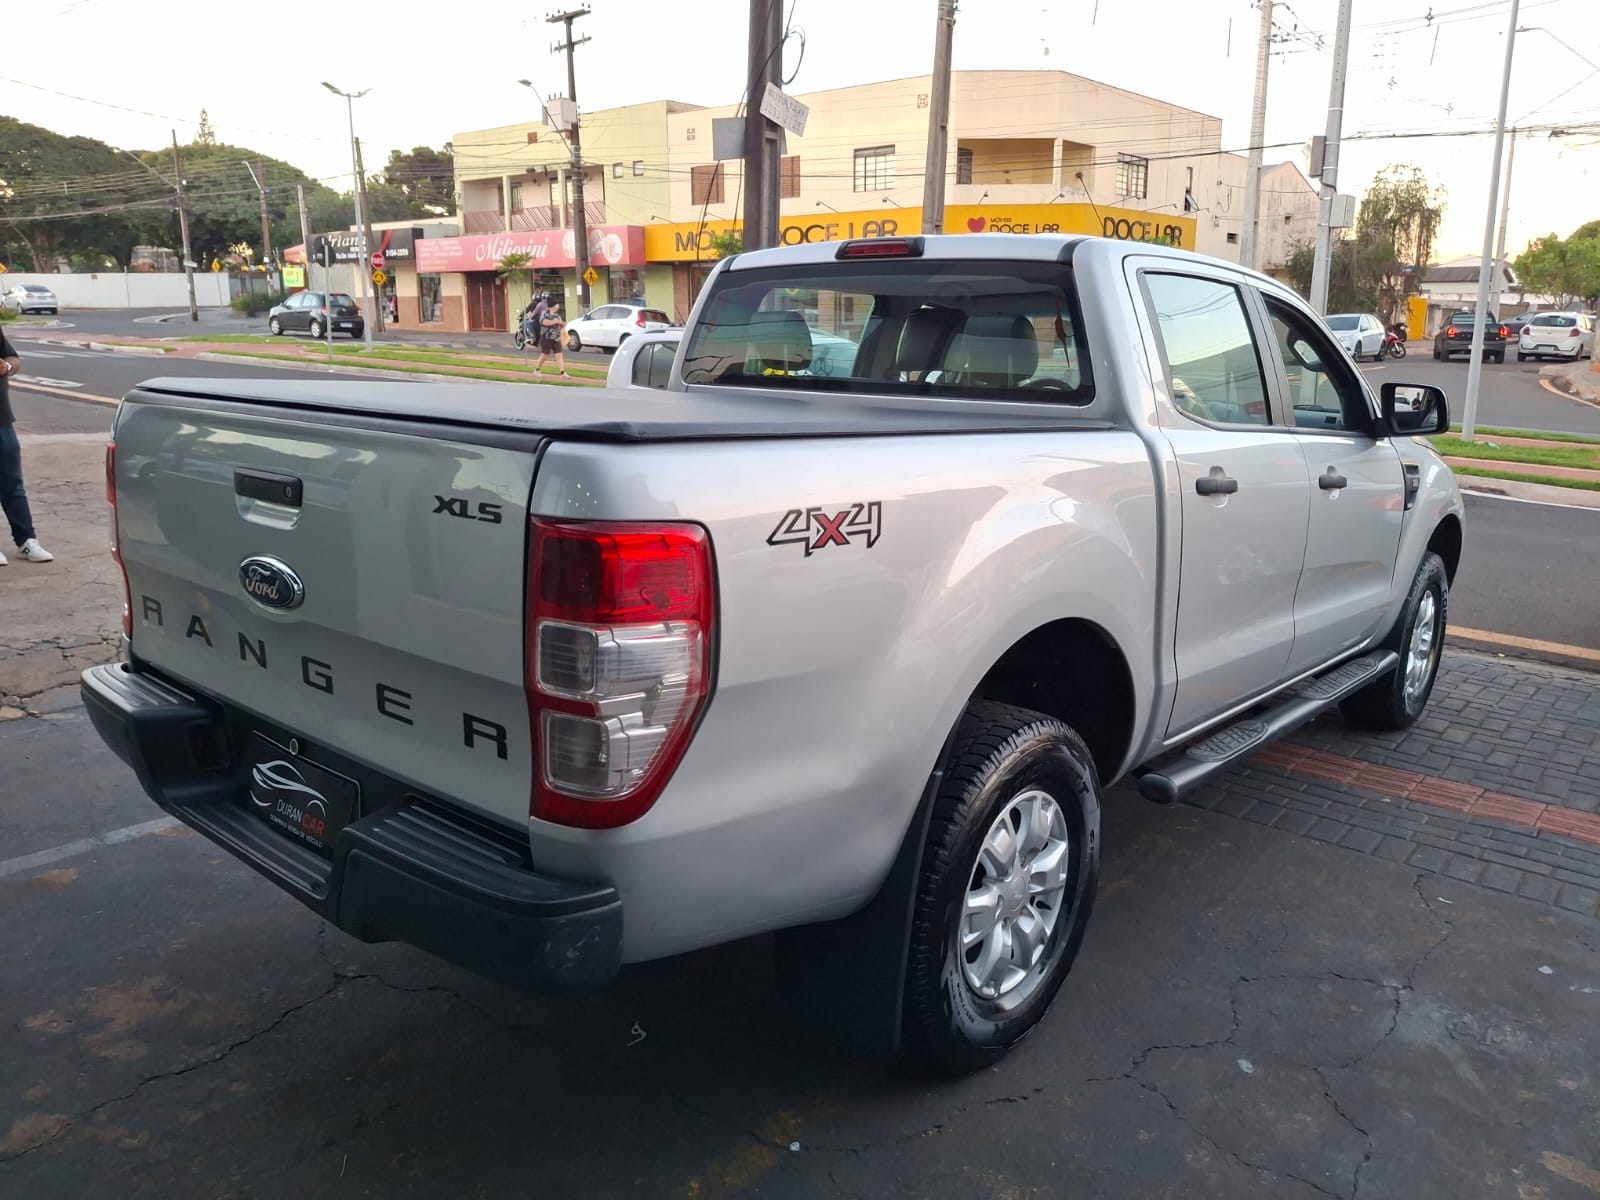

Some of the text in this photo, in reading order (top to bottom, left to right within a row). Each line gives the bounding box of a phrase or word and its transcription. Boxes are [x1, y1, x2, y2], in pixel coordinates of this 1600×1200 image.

[990, 224, 1060, 234] DOCE LAR
[1103, 216, 1152, 241] DOCE
[432, 494, 503, 524] XLS
[246, 565, 280, 600] Ford
[141, 595, 508, 760] RANGER
[276, 799, 326, 837] DURAN CAR
